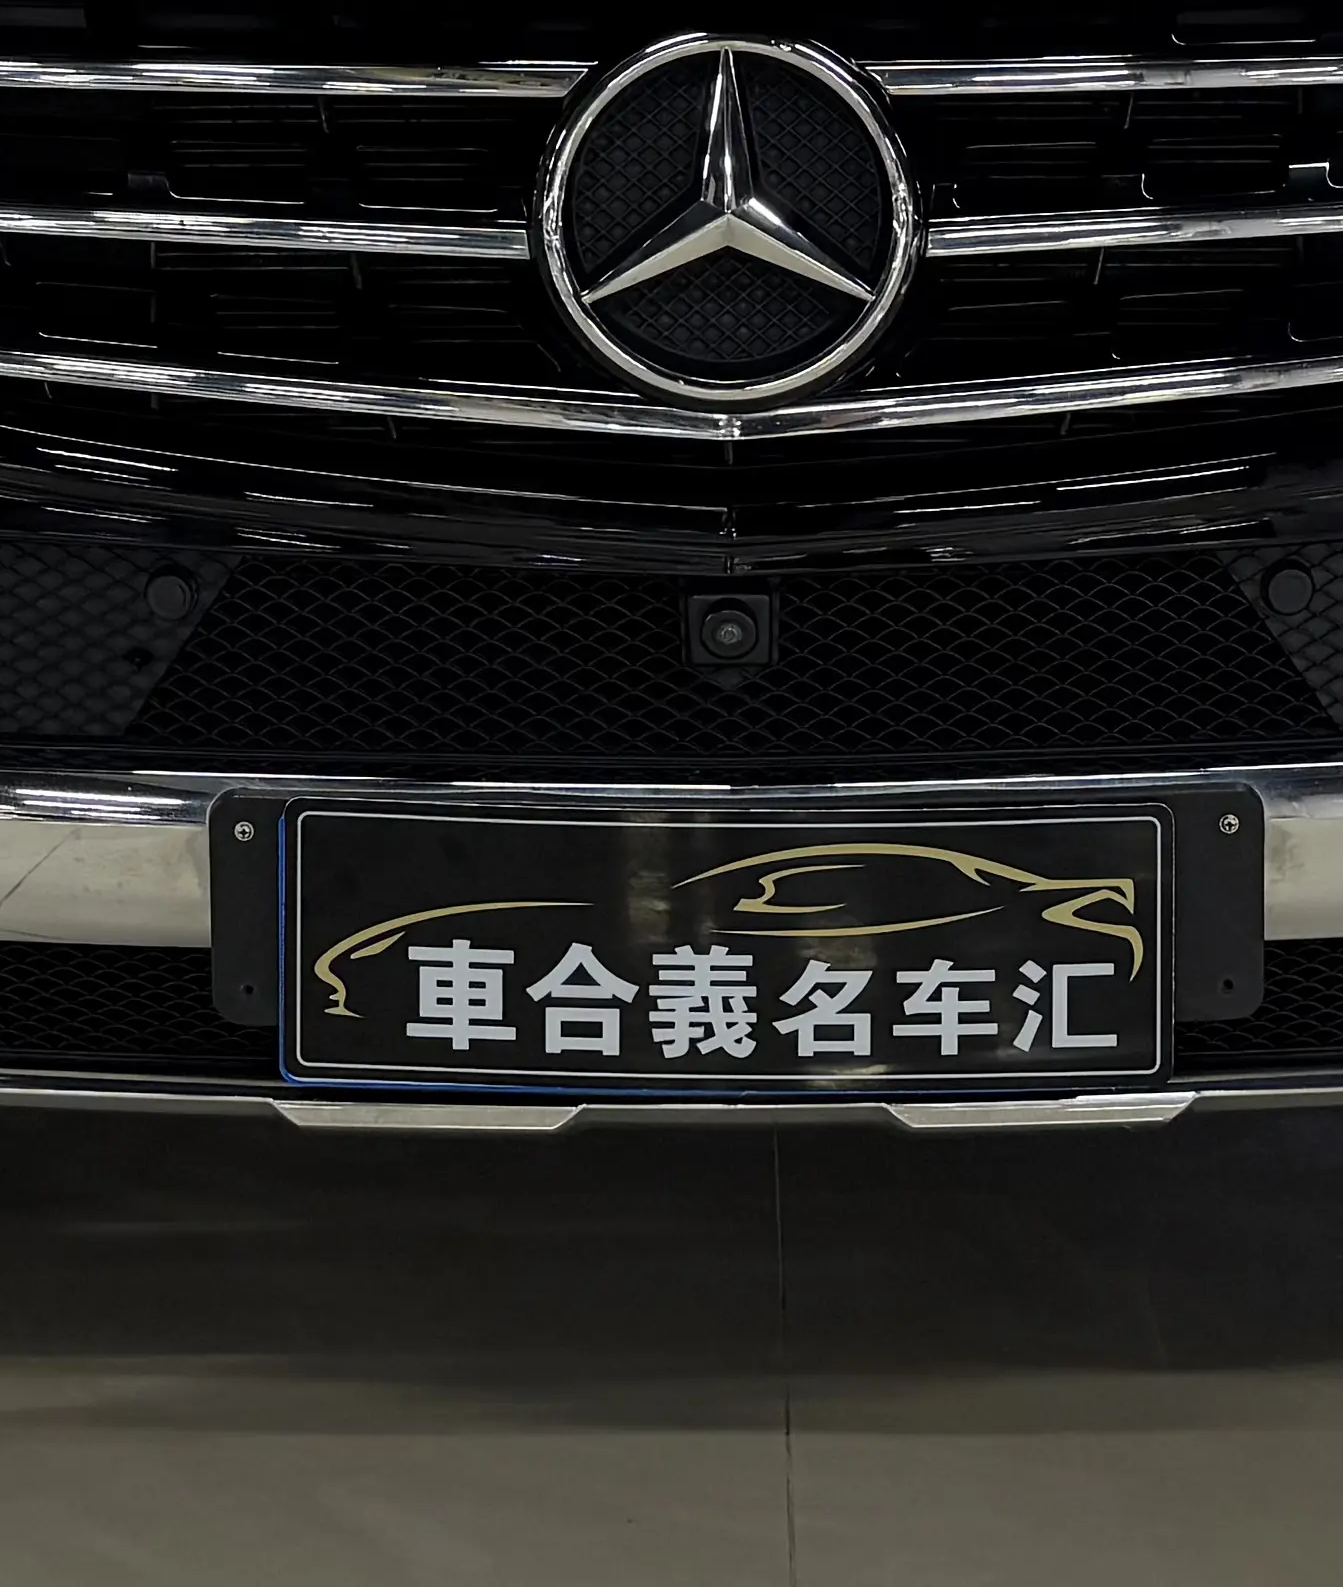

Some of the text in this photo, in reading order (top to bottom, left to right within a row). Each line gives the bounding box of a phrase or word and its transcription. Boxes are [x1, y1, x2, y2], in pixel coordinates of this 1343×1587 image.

[405, 940, 1120, 1059] 車合義名车汇
